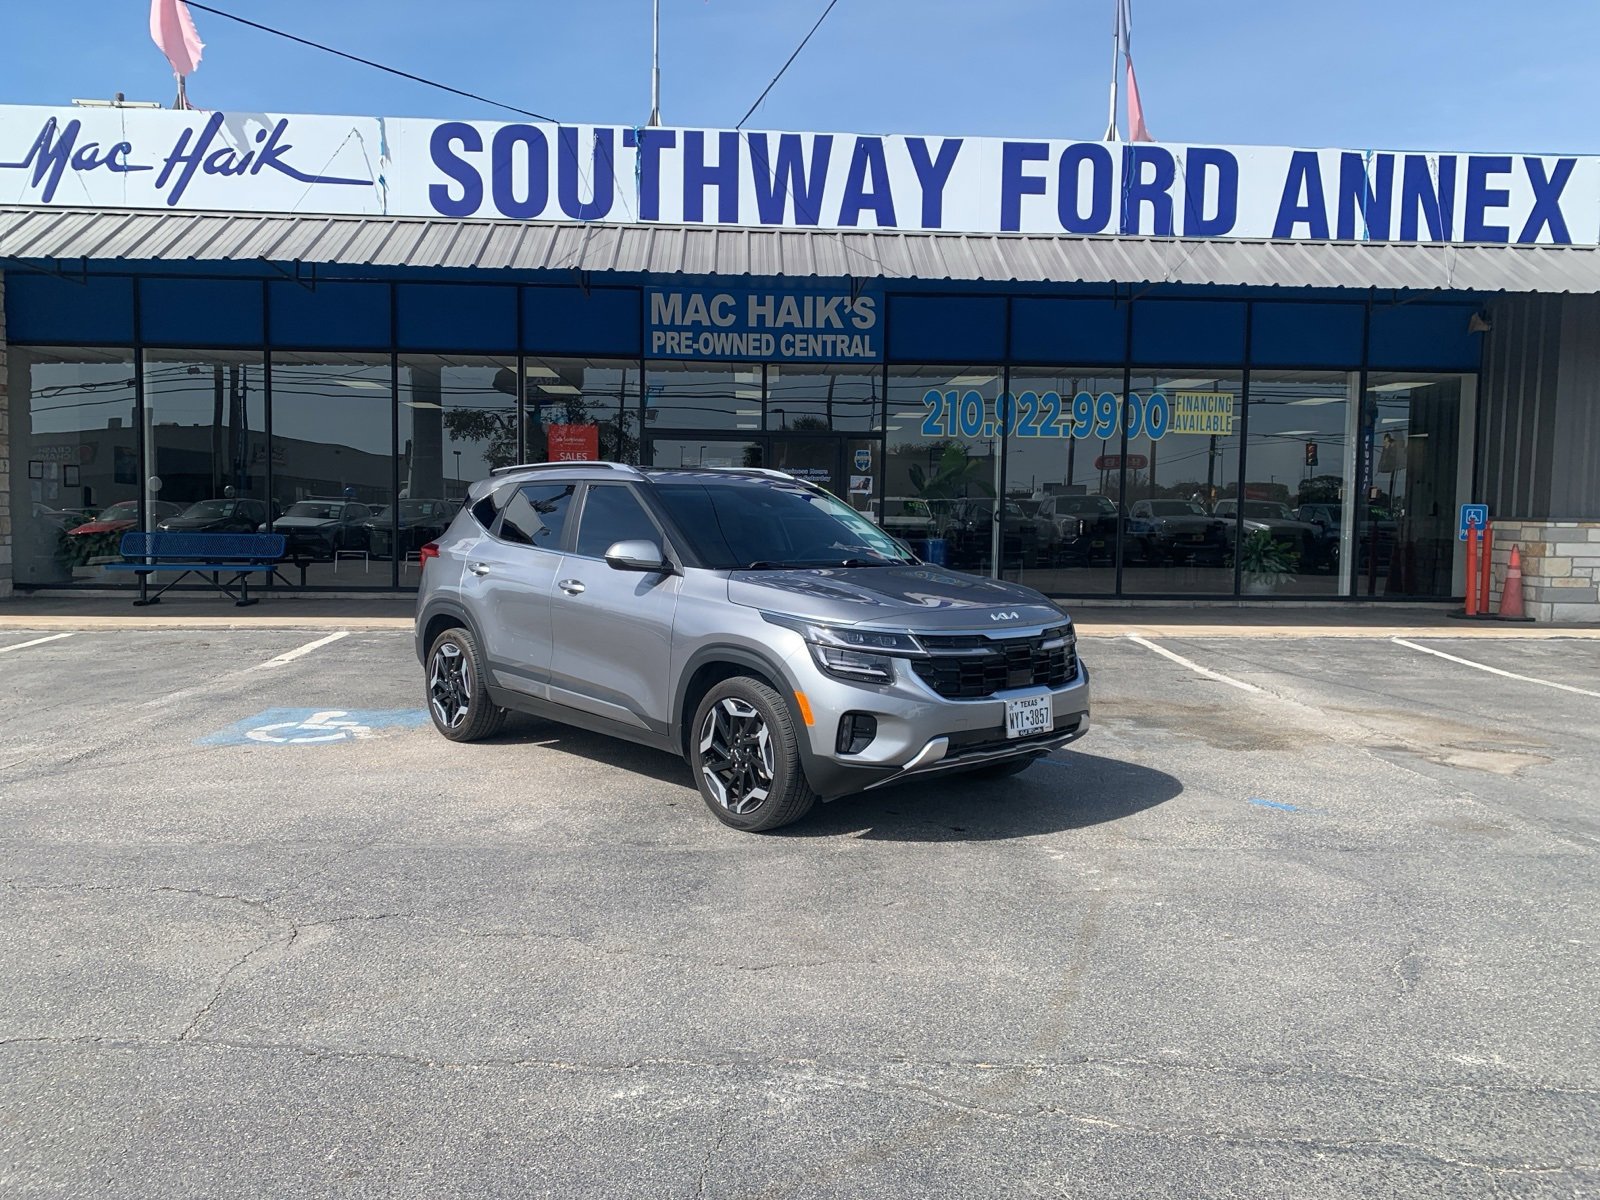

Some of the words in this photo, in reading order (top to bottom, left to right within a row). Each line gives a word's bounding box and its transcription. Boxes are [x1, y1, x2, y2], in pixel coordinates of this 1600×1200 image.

[0, 116, 153, 203] Mac
[155, 111, 373, 206] Haik
[428, 121, 964, 228] SOUTHWAY
[999, 142, 1239, 237] FORD
[1272, 150, 1577, 244] ANNEX
[651, 292, 736, 327] MAC
[747, 295, 876, 329] HAIK'S
[652, 331, 775, 356] PRE-OWNED
[780, 334, 876, 357] CENTRAL
[921, 389, 1169, 441] 210.922.9900
[1176, 394, 1232, 414] FINANCING
[1175, 413, 1232, 432] AVAILABLE
[559, 452, 588, 461] SALES
[1020, 699, 1038, 708] TEXAS
